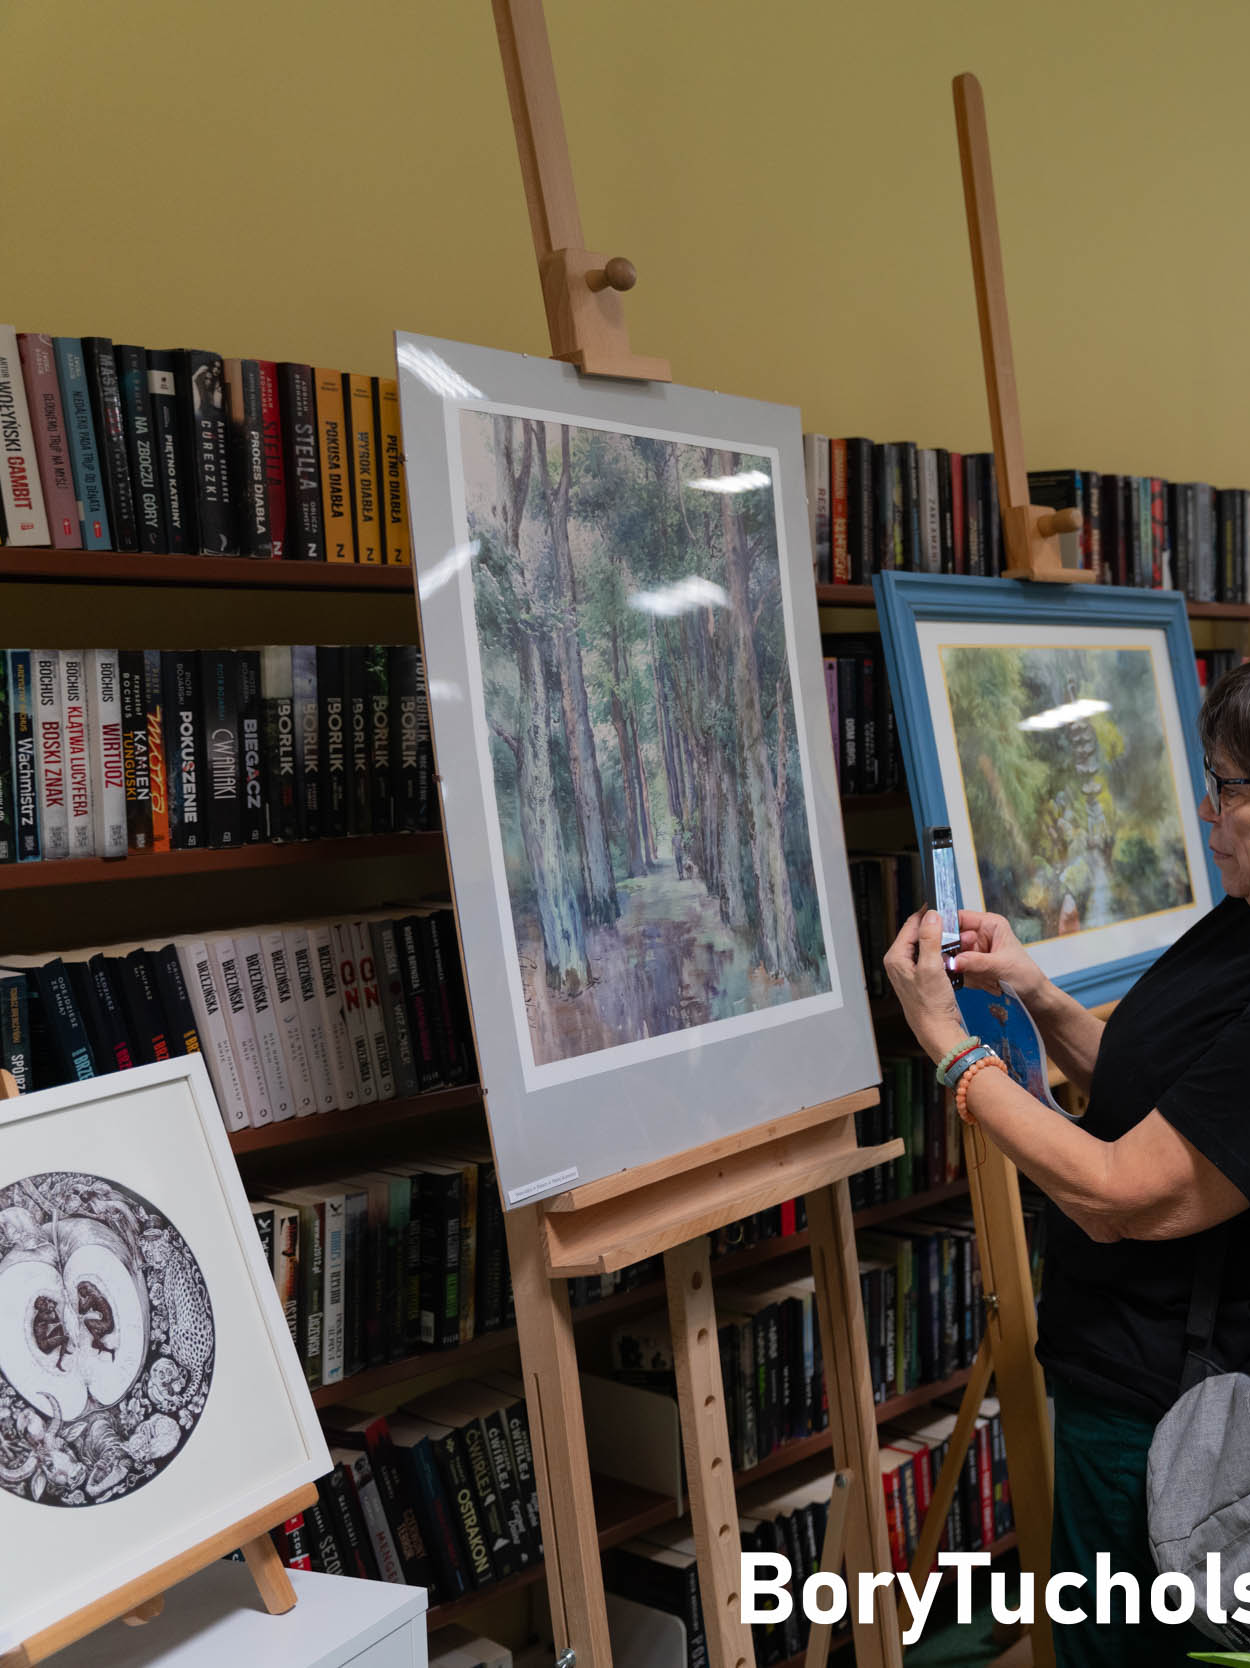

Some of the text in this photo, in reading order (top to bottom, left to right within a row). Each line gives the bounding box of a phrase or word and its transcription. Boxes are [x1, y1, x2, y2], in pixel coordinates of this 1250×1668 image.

[0, 381, 22, 452] WOŁYŃSKI
[72, 391, 88, 430] NIEDALEKO
[79, 432, 91, 451] PADA
[49, 434, 62, 456] TRUP
[82, 453, 95, 473] TRUP
[134, 416, 158, 529] NA ZBOCZU GÓRY
[294, 423, 319, 491] STELLA
[325, 421, 342, 473] POKUSA
[357, 431, 372, 475] WYROK
[386, 434, 401, 478] PIĘTNO
[8, 456, 32, 510] GAMBIT
[86, 486, 100, 513] DENATA
[164, 434, 181, 529] PIĘTNO KATRINY
[251, 430, 267, 535] PROCES DIABŁA
[329, 473, 345, 519] DIABŁA
[360, 477, 374, 524] DIABŁA
[388, 480, 402, 525] DIABŁA
[38, 660, 54, 706] BOCHUS
[66, 661, 80, 702] BOCHUS
[101, 663, 114, 703] BOCHUS
[122, 672, 133, 719] BOCHUS
[42, 721, 64, 808] BOSKI ZNAK
[65, 706, 88, 818] KLĄTWA LUCYFERA
[102, 723, 123, 789] WIRTUOZ
[123, 732, 137, 801] TUNGUSKI
[211, 728, 237, 800] CWANIAKI
[243, 718, 262, 809] BIEGACZ
[277, 702, 294, 777] BORLIK
[303, 703, 321, 775] BORLIK
[328, 702, 344, 774] BORLIK
[353, 702, 367, 773] BORLIK
[373, 701, 390, 770] BORLIK
[401, 701, 418, 770] BORLIK
[17, 737, 34, 826] Wachmistrz
[178, 710, 199, 824] POKUSZENIE
[196, 960, 219, 1016] BRZEZIŃSKA
[222, 959, 245, 1015] BRZEZIŃSKA
[246, 953, 269, 1015] BRZEZIŃSKA
[271, 949, 291, 1004] BRZEZIŃSKA
[295, 948, 315, 1002] BRZEZIŃSKA
[317, 945, 337, 999] BRZEZIŃSKA
[307, 1311, 323, 1358] CISZEWSKI
[465, 1428, 491, 1497] ĆWIRLEJ
[488, 1427, 511, 1490] ĆWIRLEJ
[457, 1488, 490, 1575] OSTRAKON
